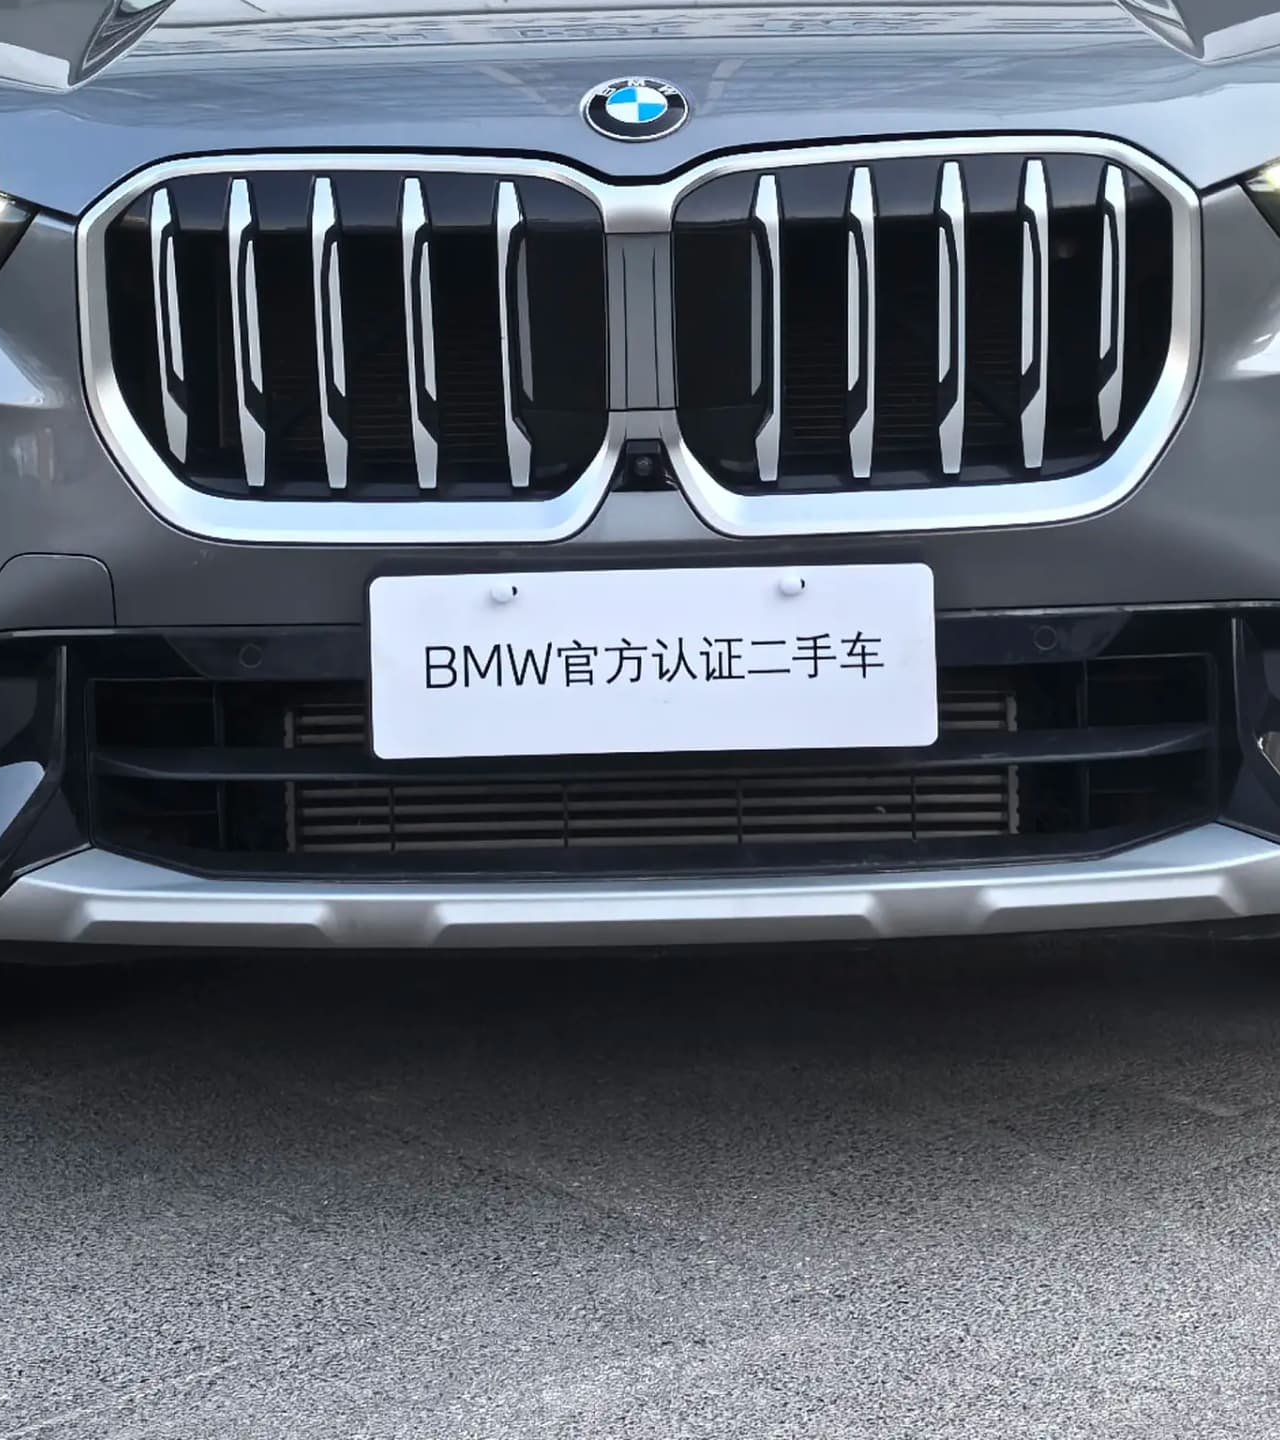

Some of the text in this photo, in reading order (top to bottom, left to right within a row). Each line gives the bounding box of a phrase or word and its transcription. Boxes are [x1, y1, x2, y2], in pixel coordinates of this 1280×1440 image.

[424, 630, 885, 690] BMW官方认证二手车
